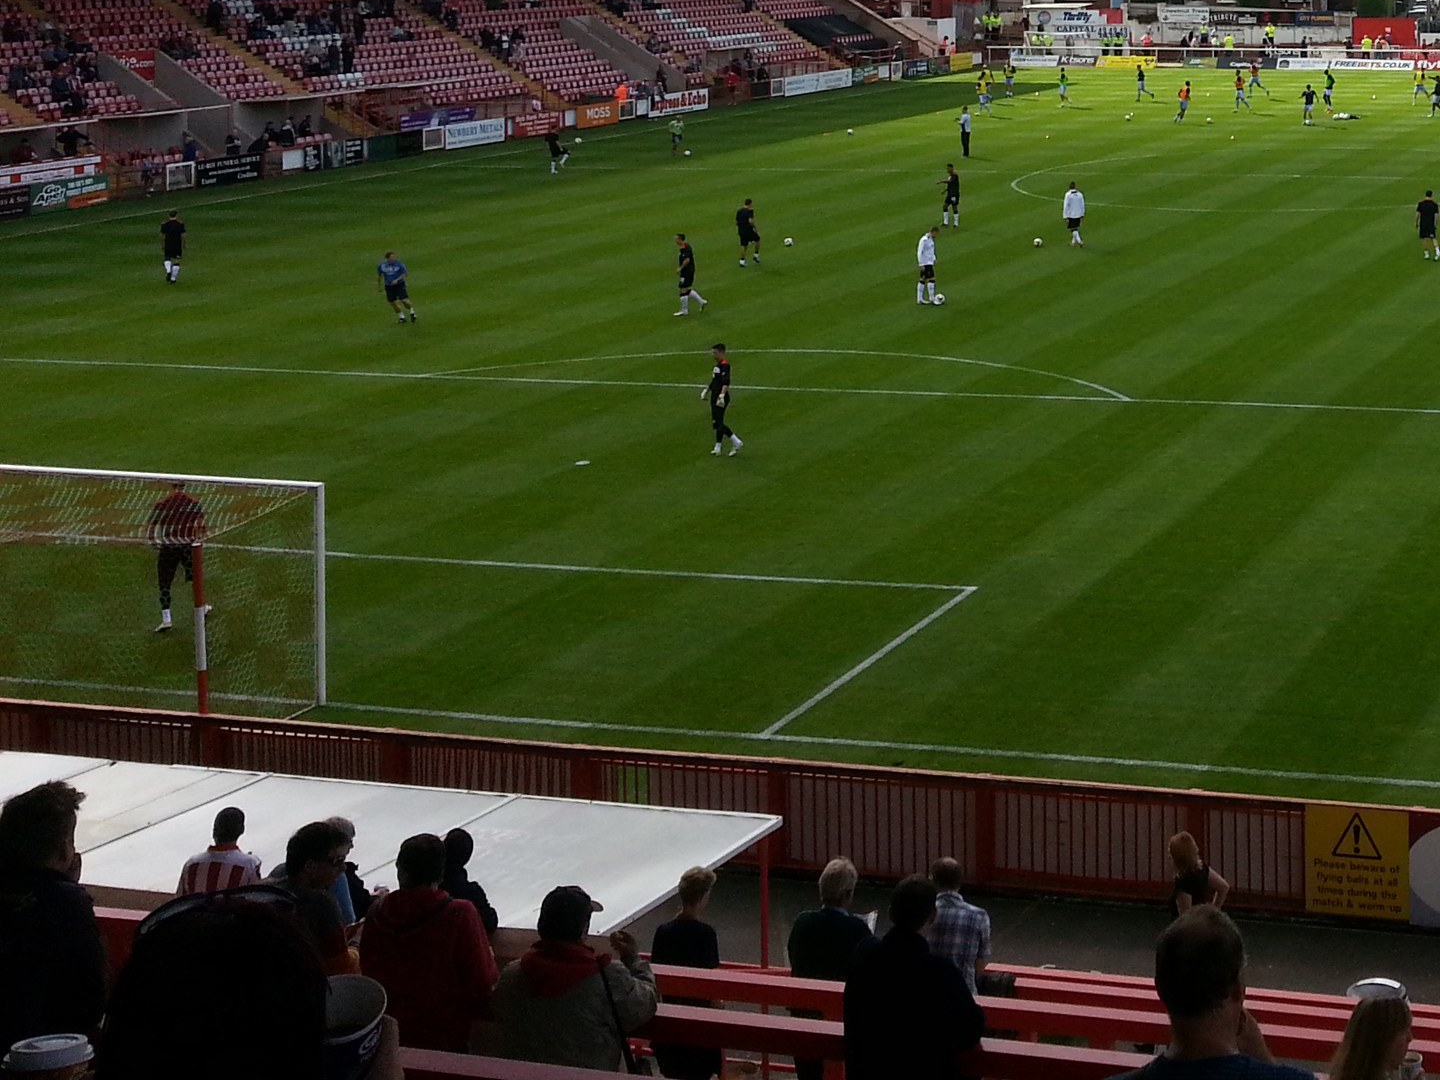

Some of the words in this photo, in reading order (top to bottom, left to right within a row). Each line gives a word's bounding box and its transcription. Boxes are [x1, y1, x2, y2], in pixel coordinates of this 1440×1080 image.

[1063, 11, 1093, 23] Thrifty
[688, 91, 707, 109] Echo
[586, 106, 611, 119] MOSS
[43, 185, 61, 195] Go
[1314, 858, 1345, 869] Please
[1350, 861, 1386, 873] beware
[1317, 871, 1343, 884] flying
[1347, 874, 1369, 885] balls
[1387, 878, 1398, 887] all
[1317, 885, 1344, 895] times
[1347, 888, 1377, 900] during
[1381, 890, 1397, 900] the
[1312, 897, 1343, 907] match
[1346, 899, 1353, 908] &
